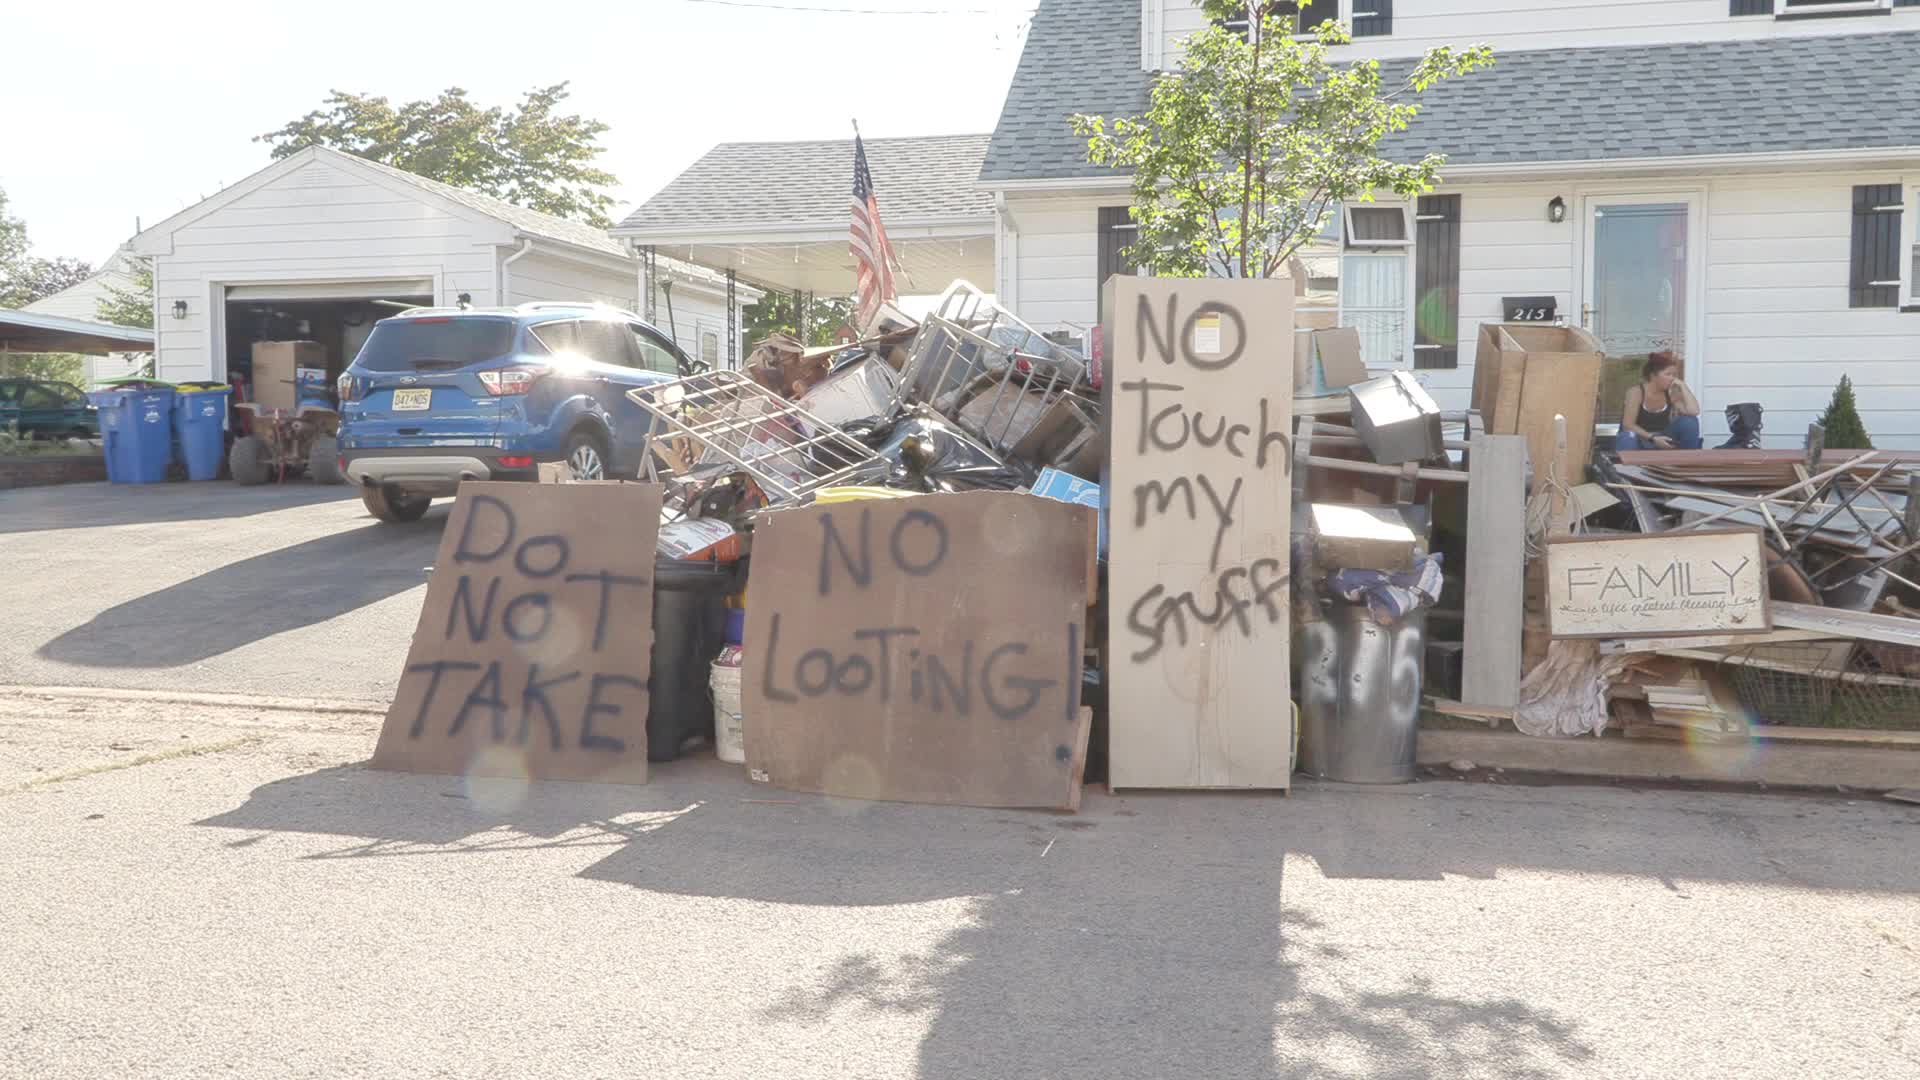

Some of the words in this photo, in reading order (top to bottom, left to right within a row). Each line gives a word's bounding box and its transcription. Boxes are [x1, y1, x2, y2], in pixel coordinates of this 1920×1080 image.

[1135, 292, 1247, 371] NO
[1513, 308, 1547, 320] 215
[817, 506, 949, 597] NO
[1567, 555, 1750, 601] FAMILY
[445, 569, 650, 653] NOT
[406, 660, 650, 752] TAKE
